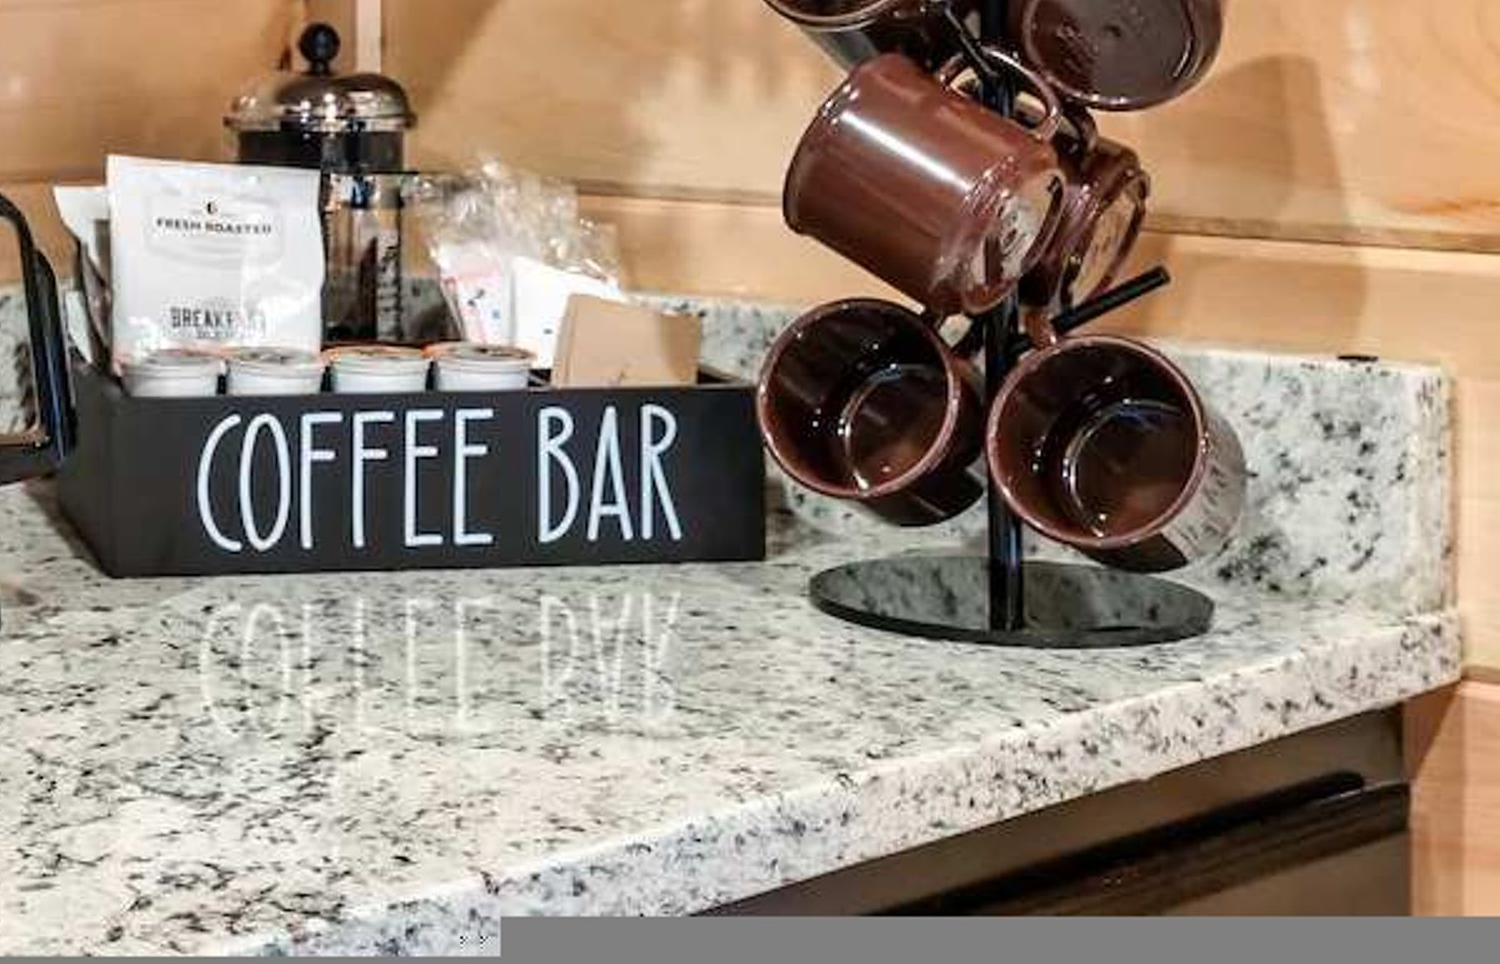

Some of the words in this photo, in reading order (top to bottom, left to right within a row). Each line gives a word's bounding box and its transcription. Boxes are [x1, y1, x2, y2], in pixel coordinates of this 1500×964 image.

[156, 217, 202, 231] FRESH
[204, 221, 272, 235] ROASTED
[197, 408, 495, 552] COFFEE
[537, 403, 683, 544] BAR
